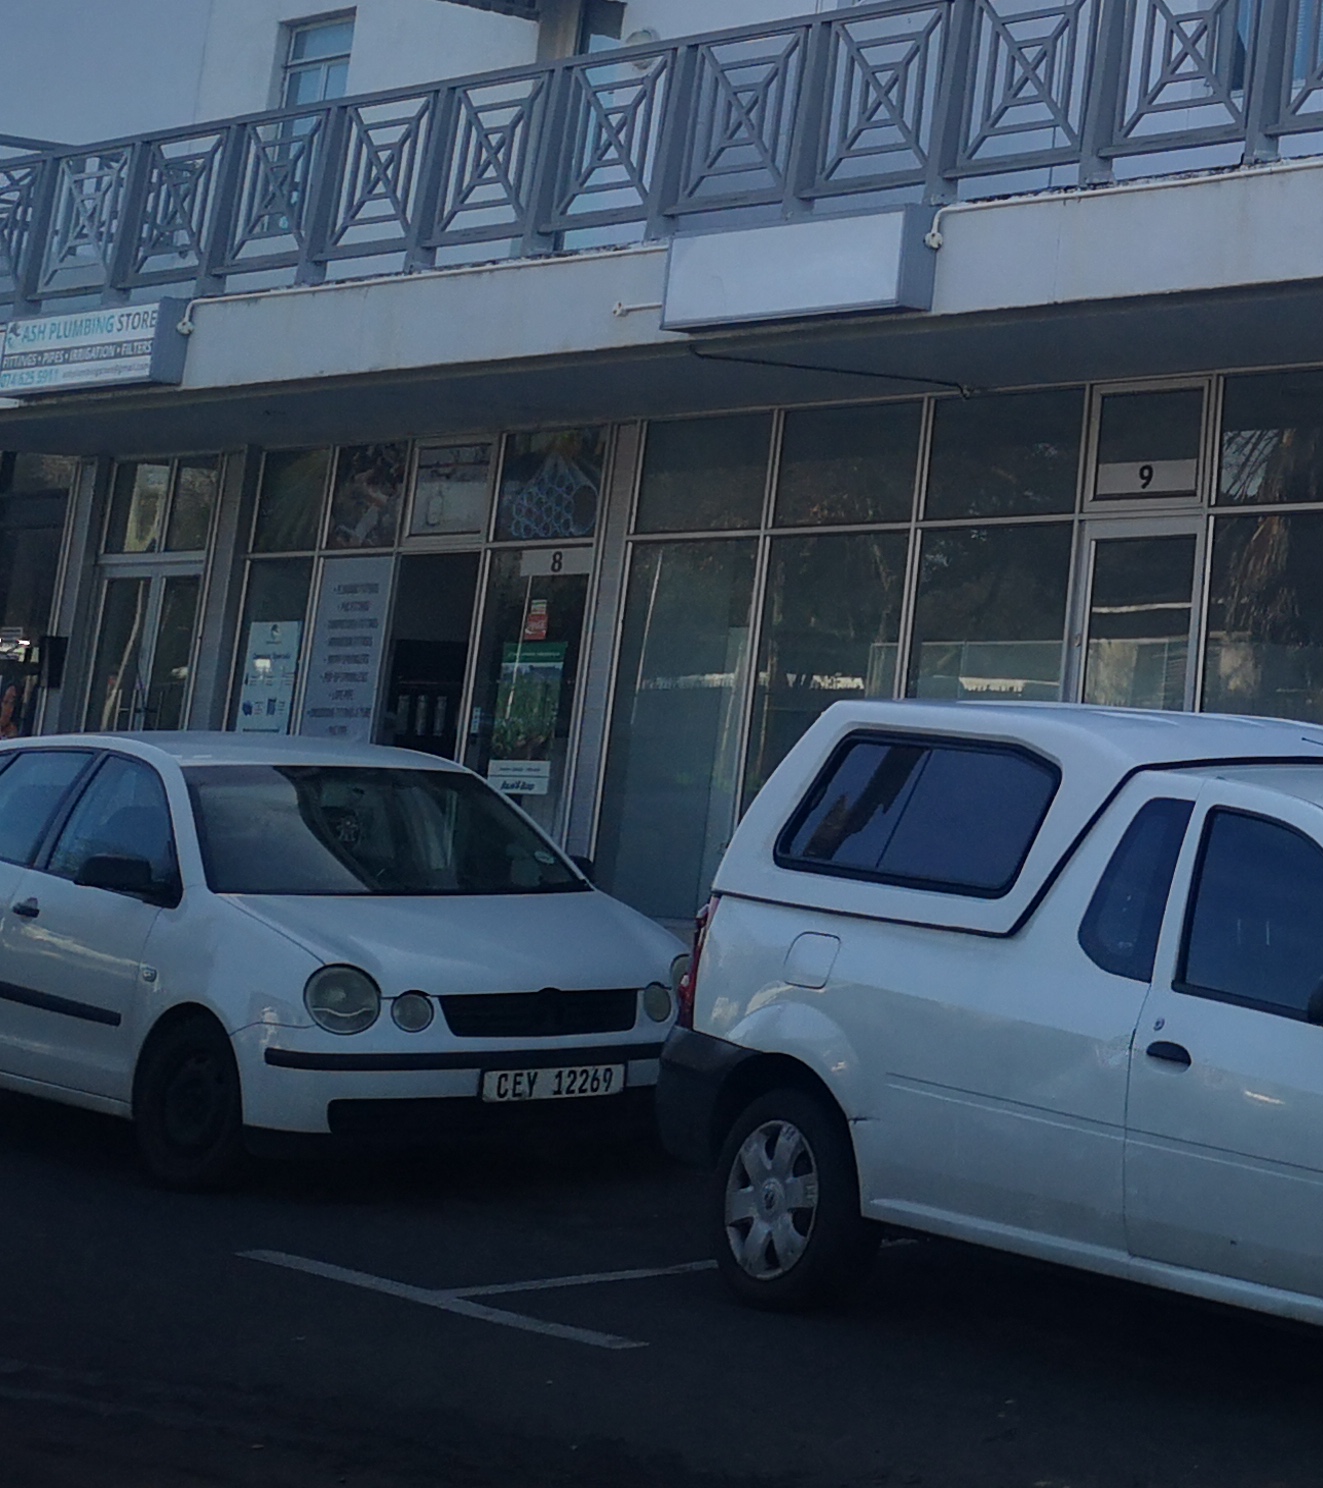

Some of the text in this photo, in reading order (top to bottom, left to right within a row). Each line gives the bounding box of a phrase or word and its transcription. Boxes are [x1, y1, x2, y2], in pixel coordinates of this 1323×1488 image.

[21, 310, 159, 344] ASH PLUMBING STORE
[1139, 464, 1154, 490] 9
[551, 550, 564, 573] 8
[497, 1067, 614, 1099] CEY 12269
